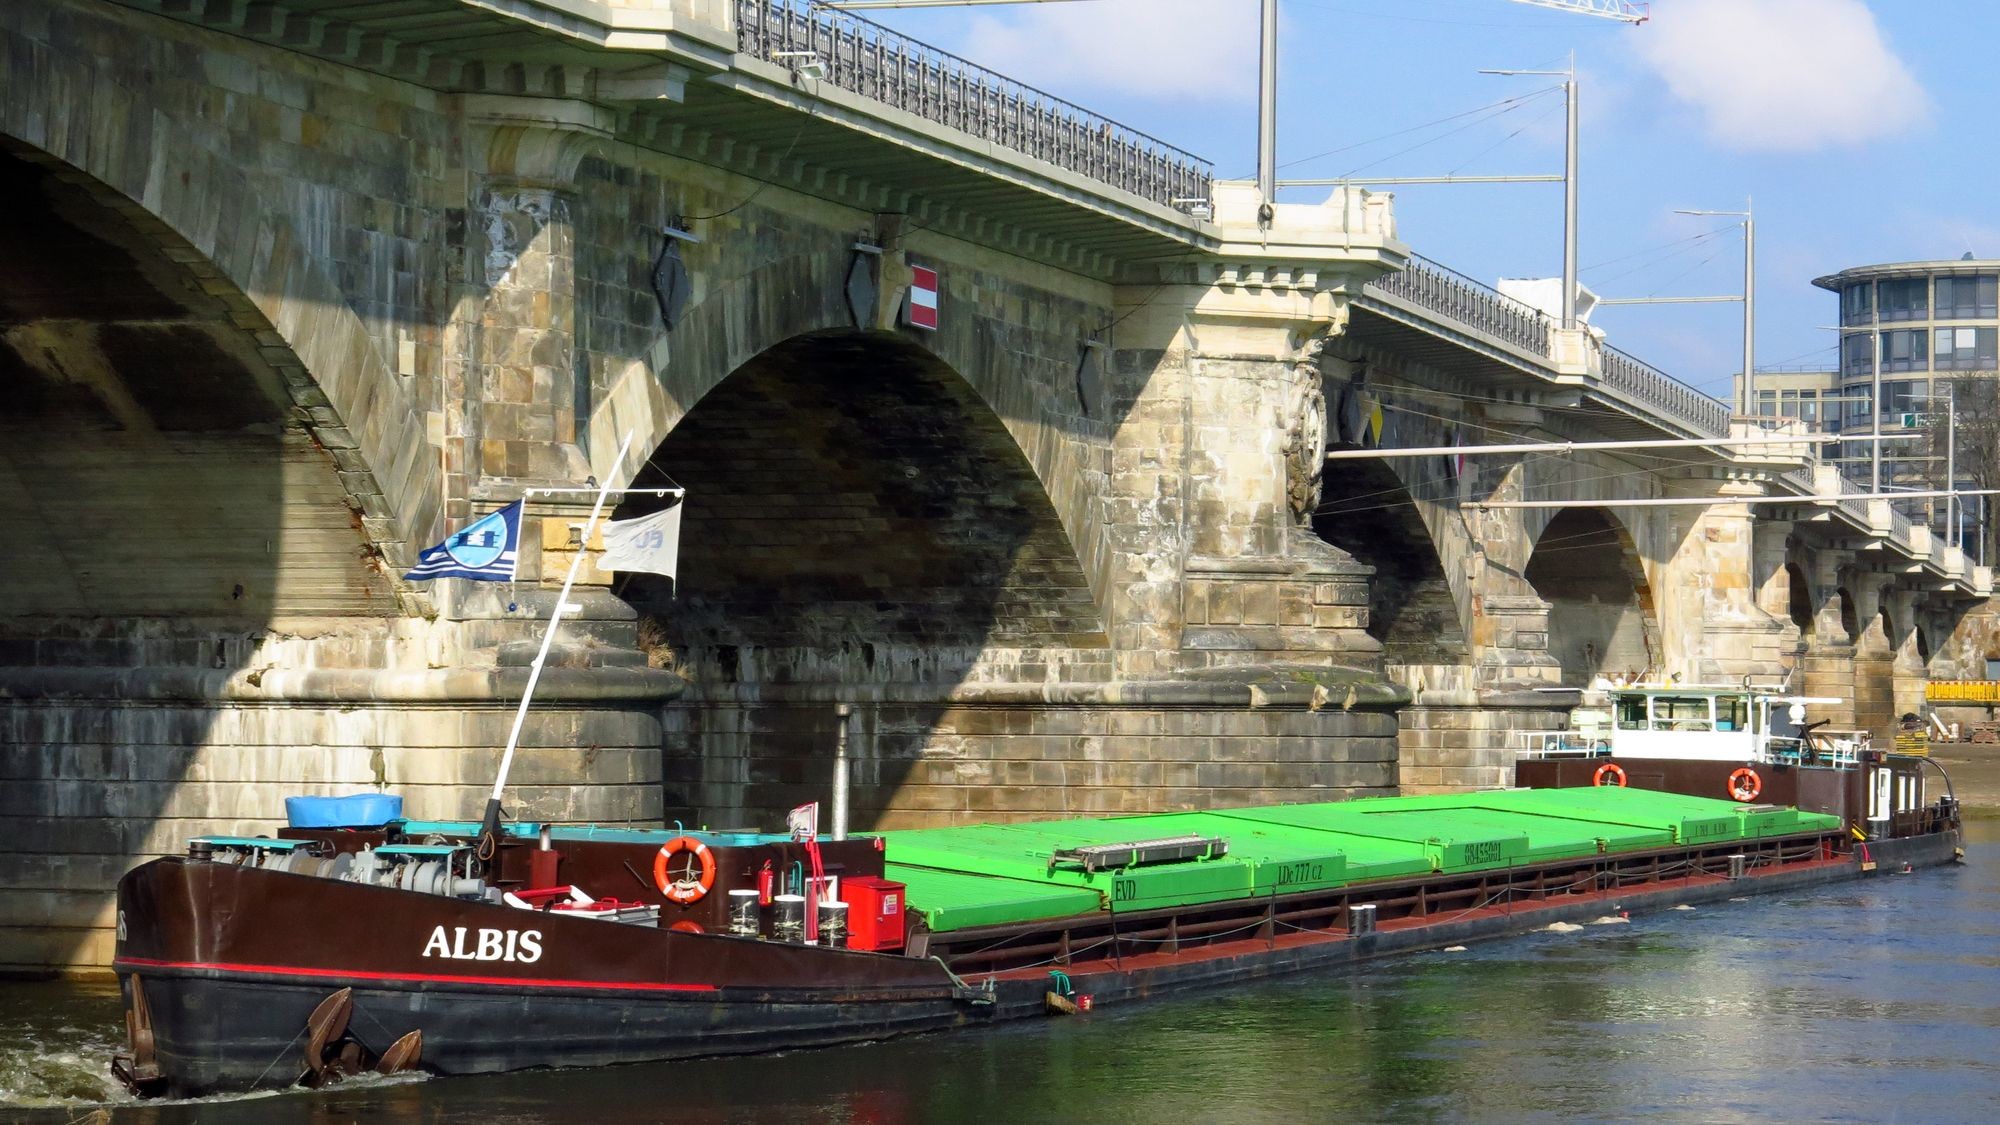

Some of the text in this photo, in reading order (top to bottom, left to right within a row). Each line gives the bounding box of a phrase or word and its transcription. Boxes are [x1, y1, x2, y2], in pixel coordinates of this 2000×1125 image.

[1295, 863, 1310, 882] 777
[1116, 880, 1136, 900] EVD
[422, 925, 542, 963] ALBIS
